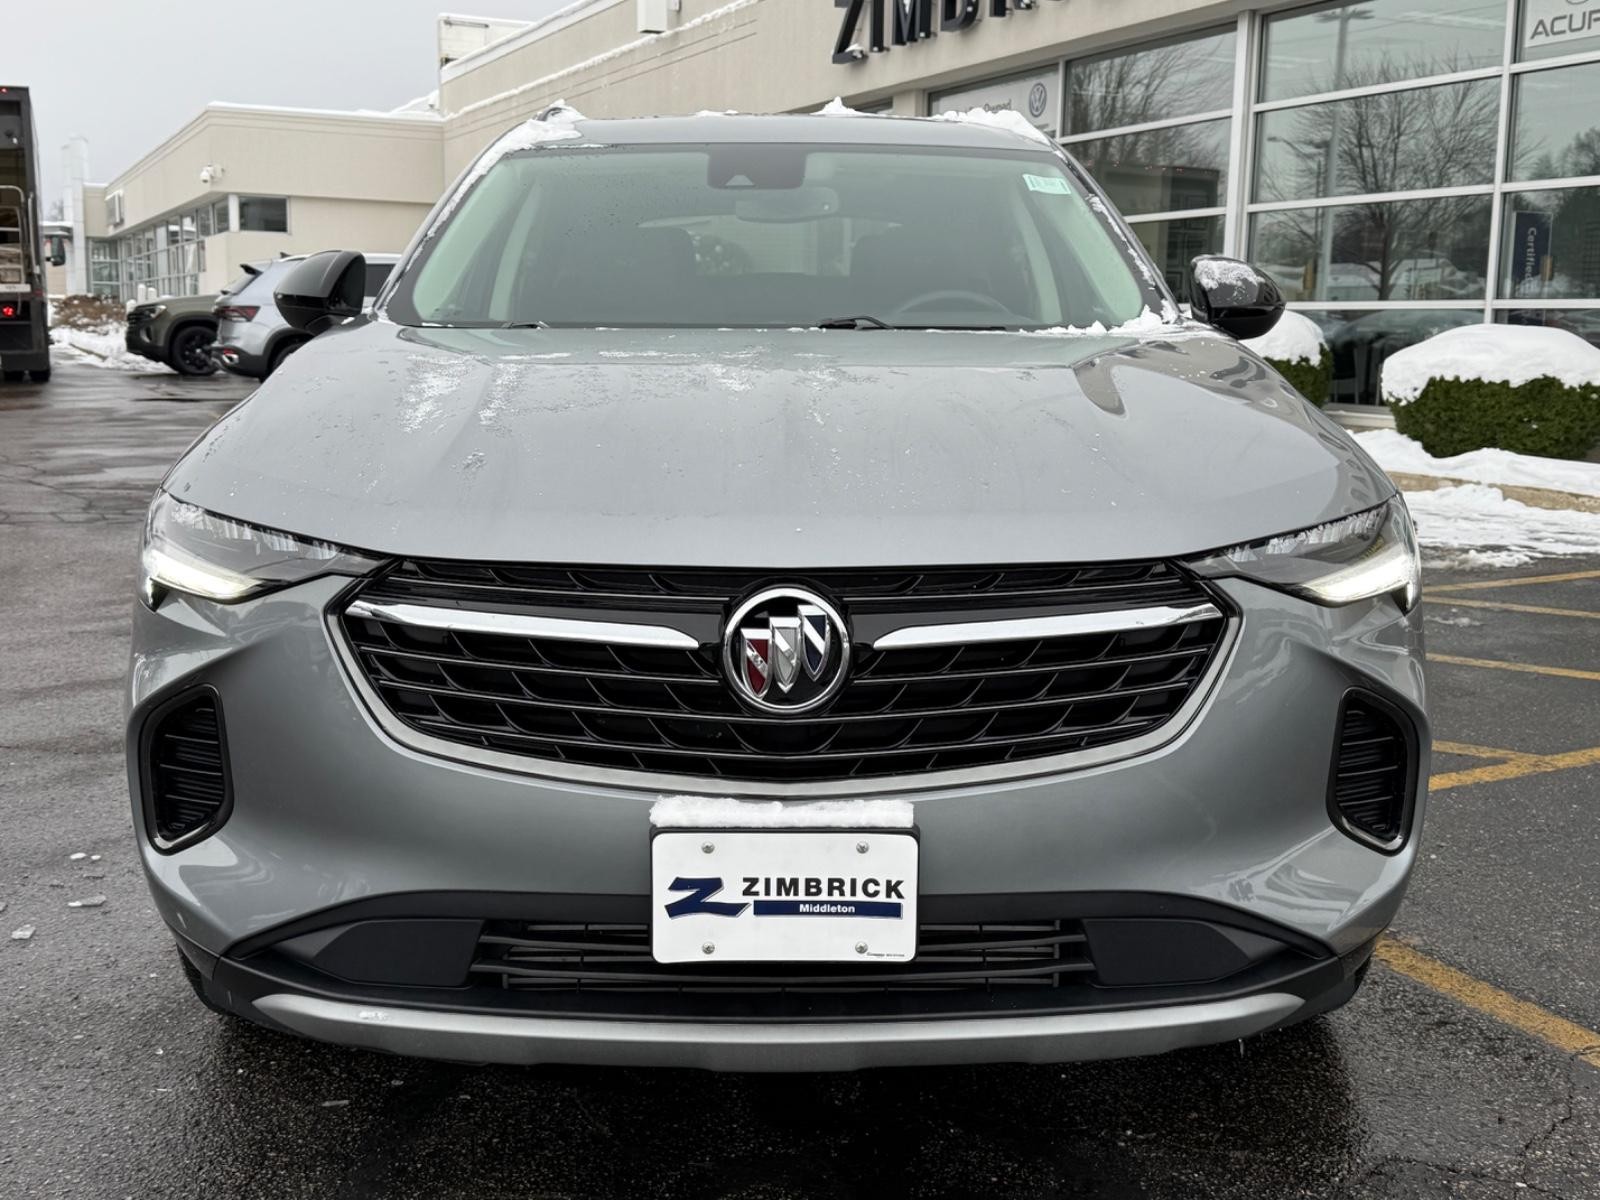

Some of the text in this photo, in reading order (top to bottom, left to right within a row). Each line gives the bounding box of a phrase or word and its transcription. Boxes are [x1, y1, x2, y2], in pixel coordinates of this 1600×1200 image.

[832, 0, 1033, 64] ZIM
[742, 877, 905, 899] ZIMBRICK
[800, 903, 855, 913] Middleton
